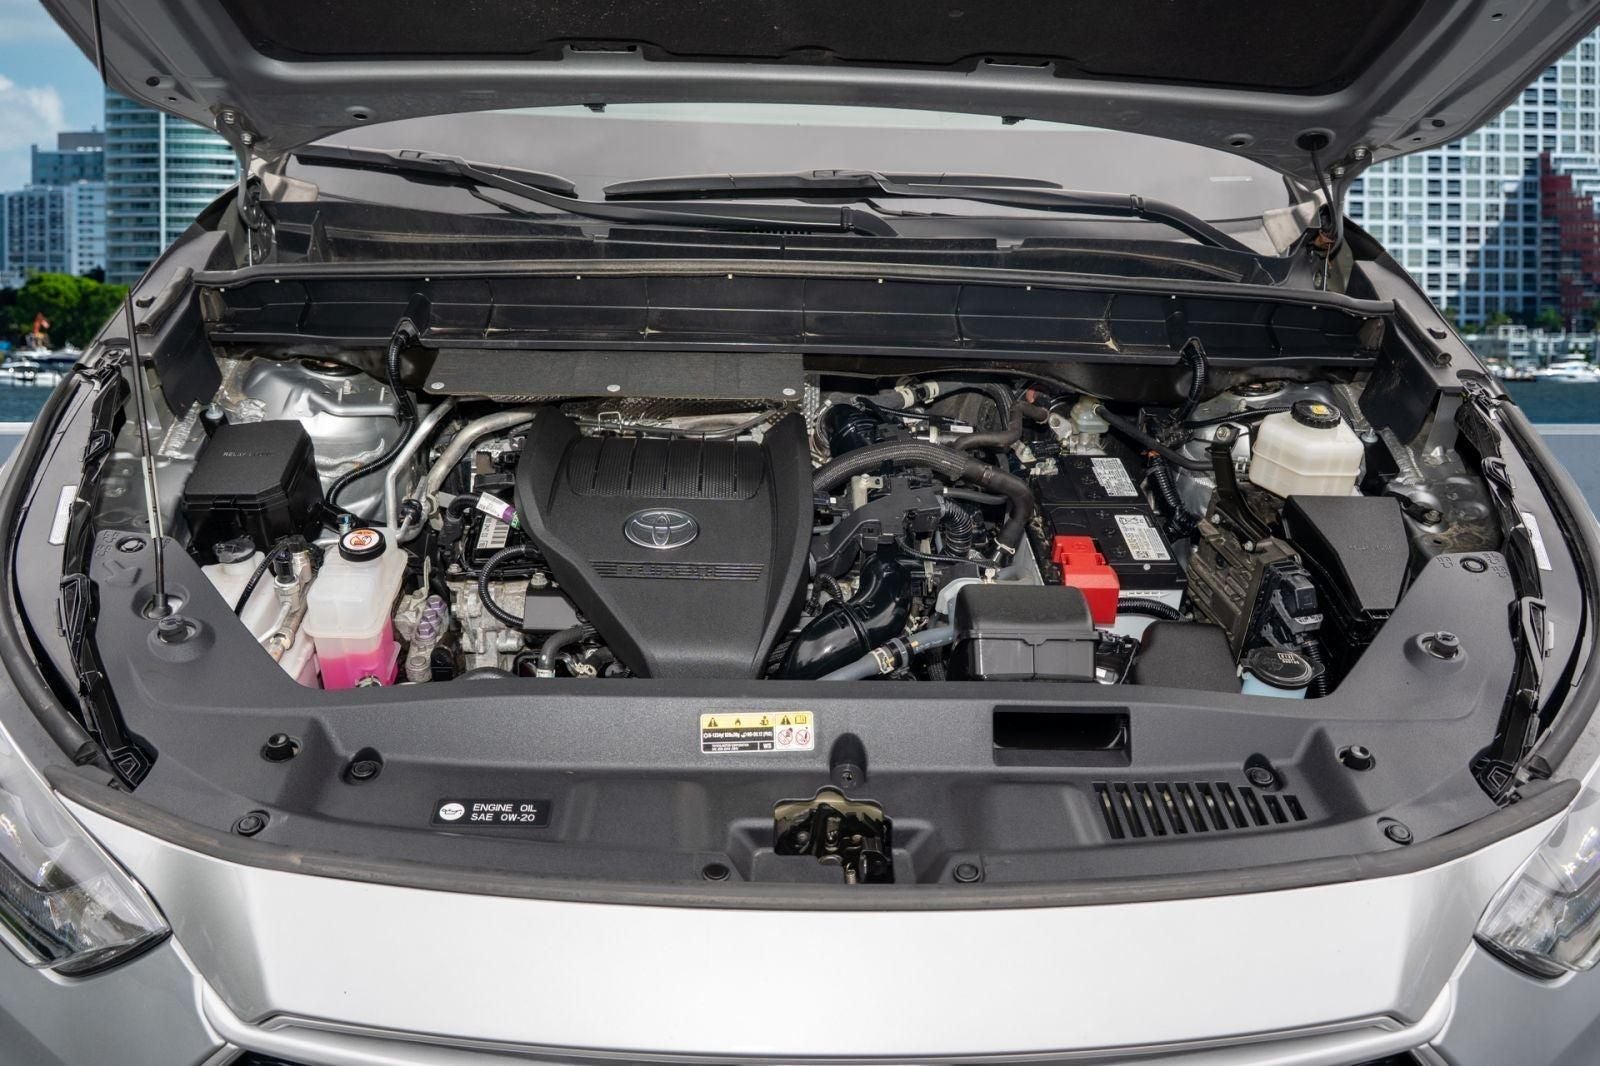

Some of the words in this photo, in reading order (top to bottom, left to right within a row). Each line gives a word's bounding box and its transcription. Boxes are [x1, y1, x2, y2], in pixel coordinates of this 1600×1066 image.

[472, 803, 514, 812] ENGINE
[520, 804, 537, 813] OIL
[470, 813, 494, 821] SAE
[500, 813, 536, 822] 0W-20
